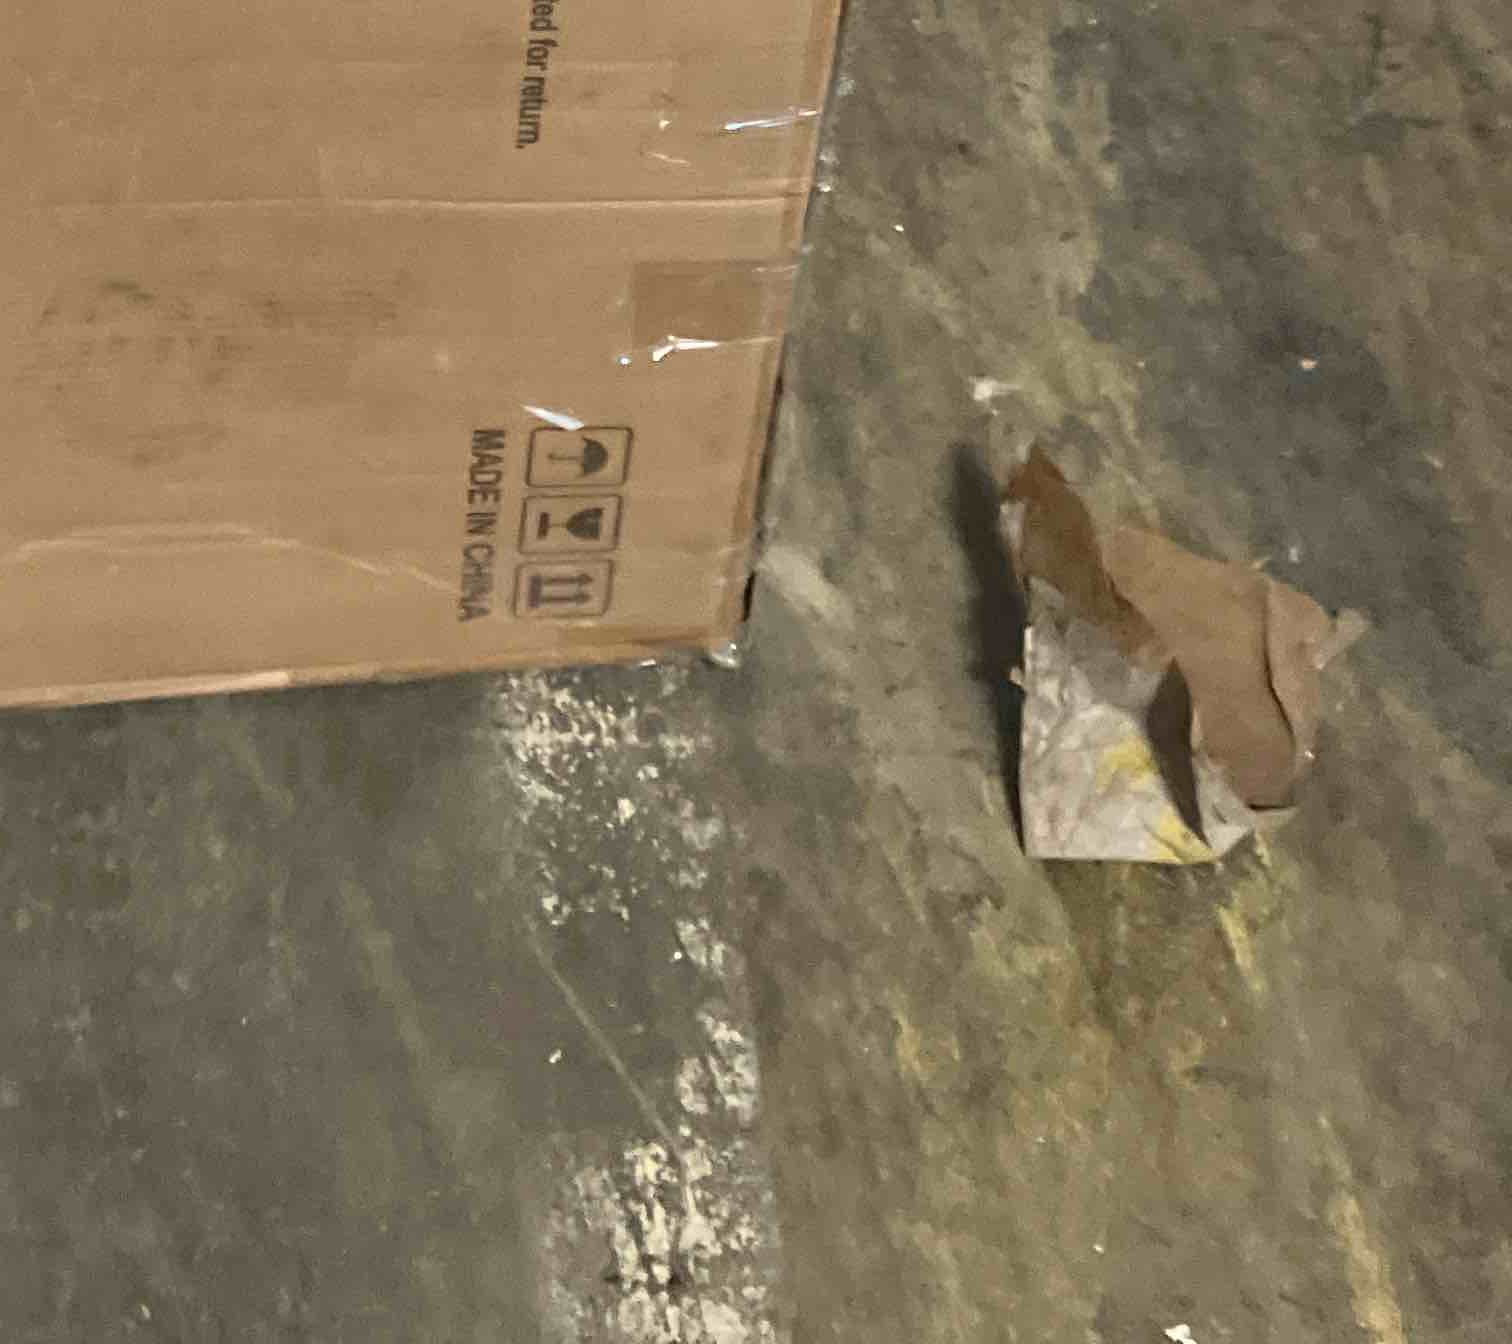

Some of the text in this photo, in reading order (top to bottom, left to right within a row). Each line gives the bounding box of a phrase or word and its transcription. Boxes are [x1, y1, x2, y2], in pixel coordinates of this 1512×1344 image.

[526, 38, 559, 73] for
[515, 76, 549, 149] return.
[457, 428, 506, 623] MADE IN CHINA
